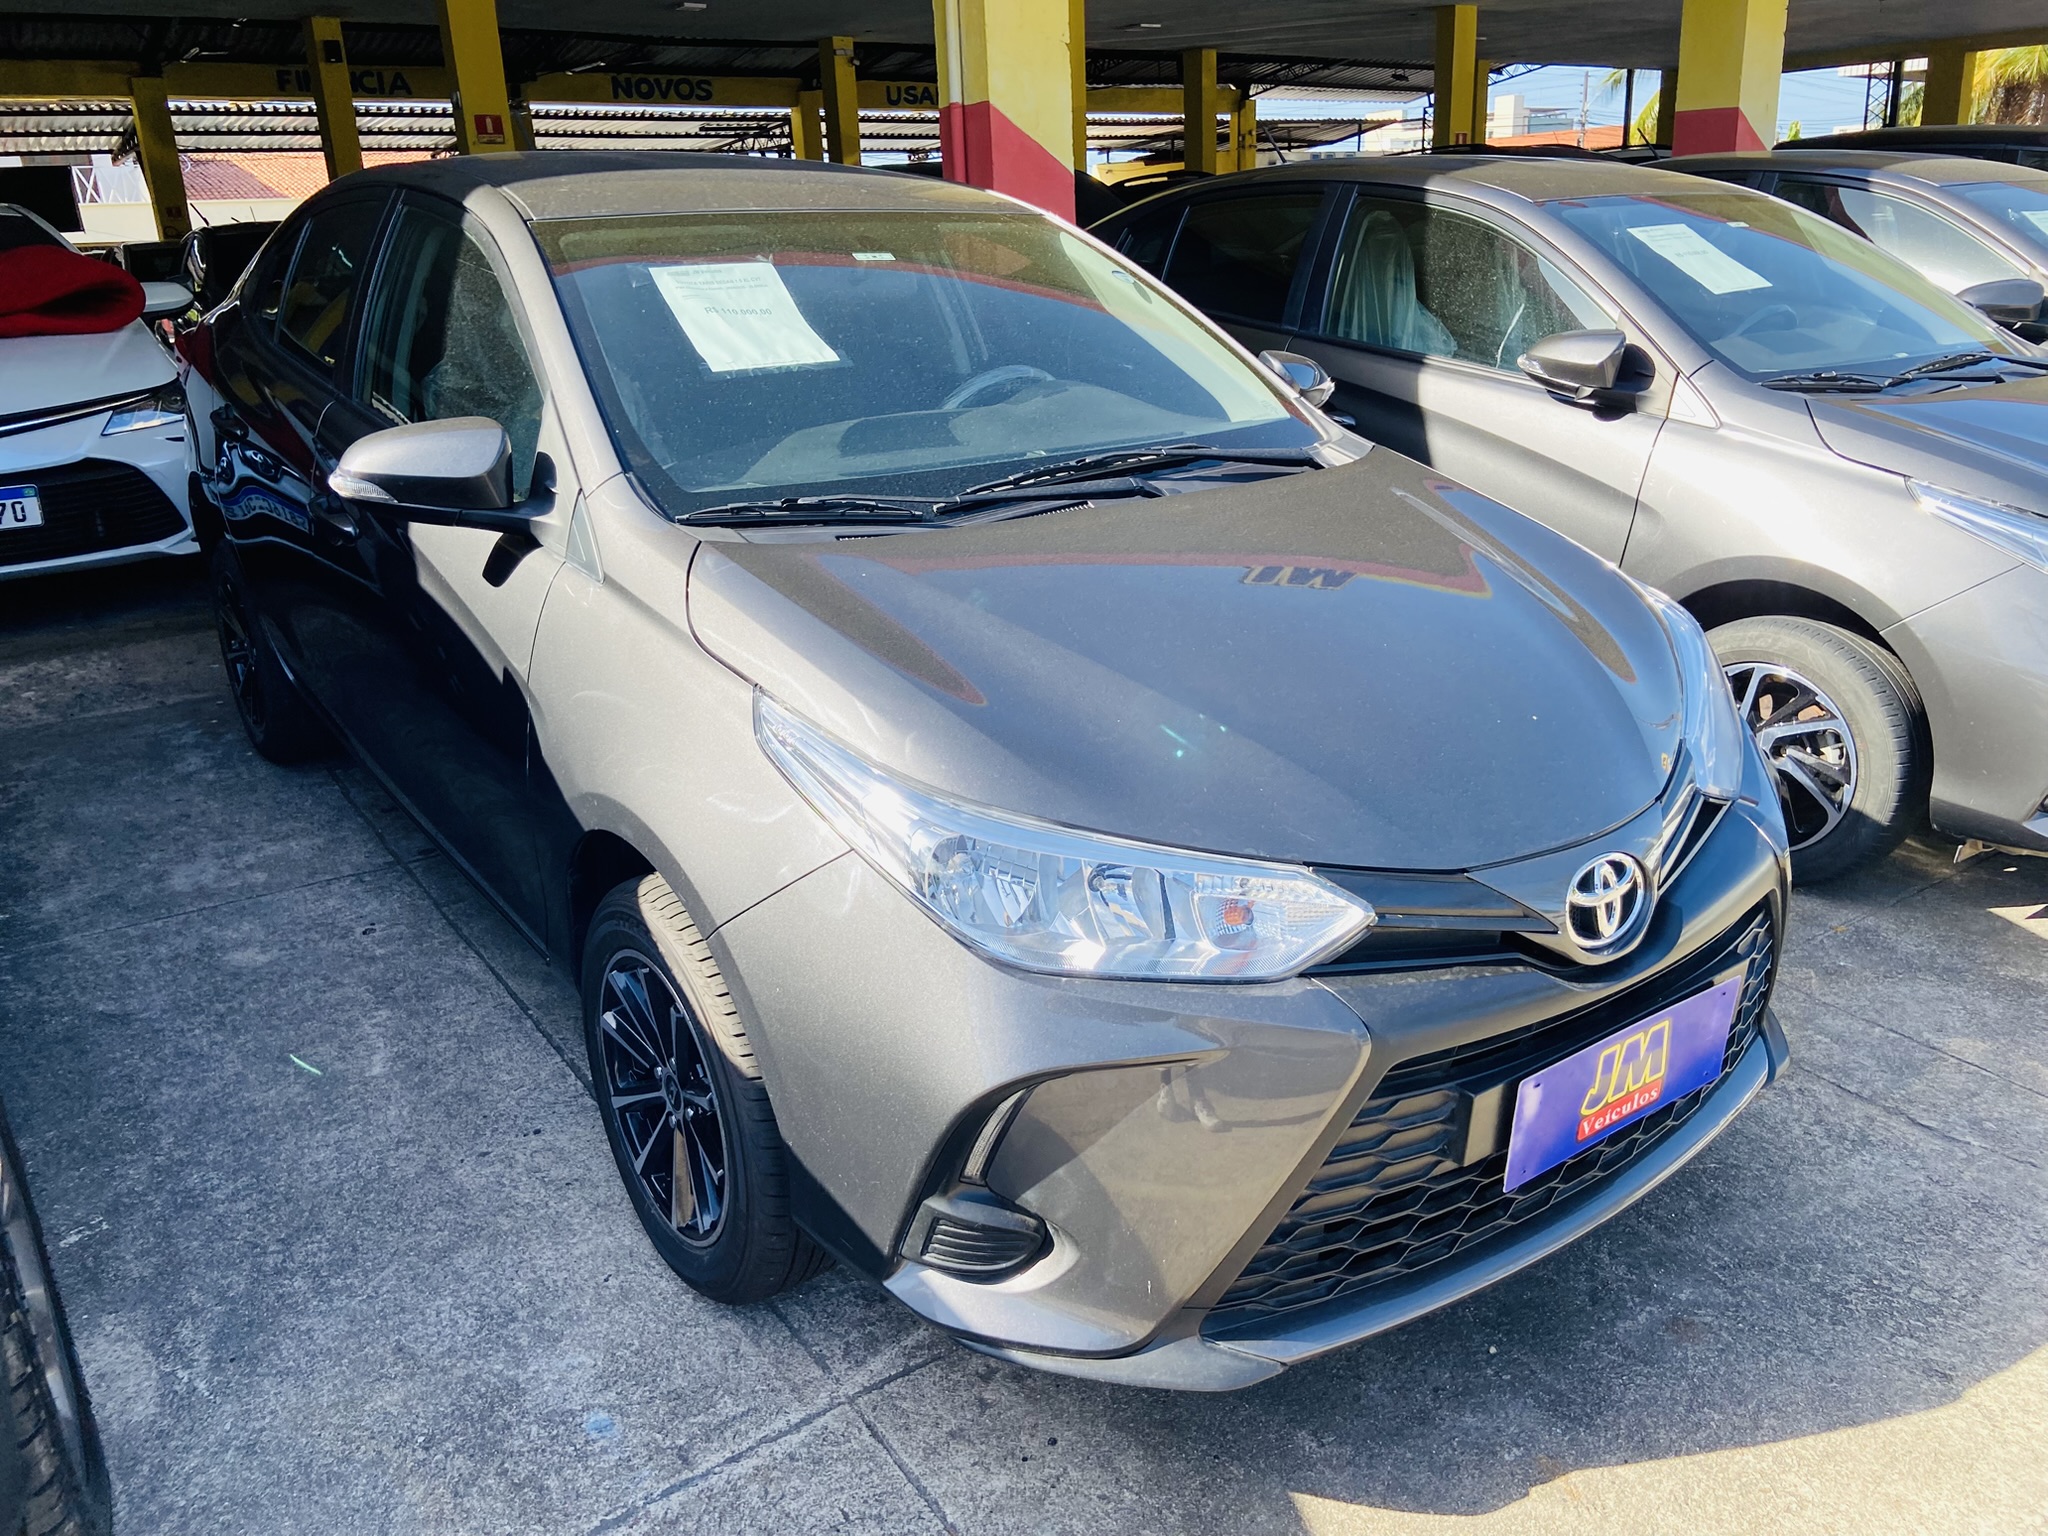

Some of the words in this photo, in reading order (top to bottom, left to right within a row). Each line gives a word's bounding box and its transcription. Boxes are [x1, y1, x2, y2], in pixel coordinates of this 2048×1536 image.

[275, 69, 413, 96] FICIA
[611, 74, 714, 101] NOVOS
[885, 84, 940, 106] USA
[1580, 1019, 1670, 1117] JM
